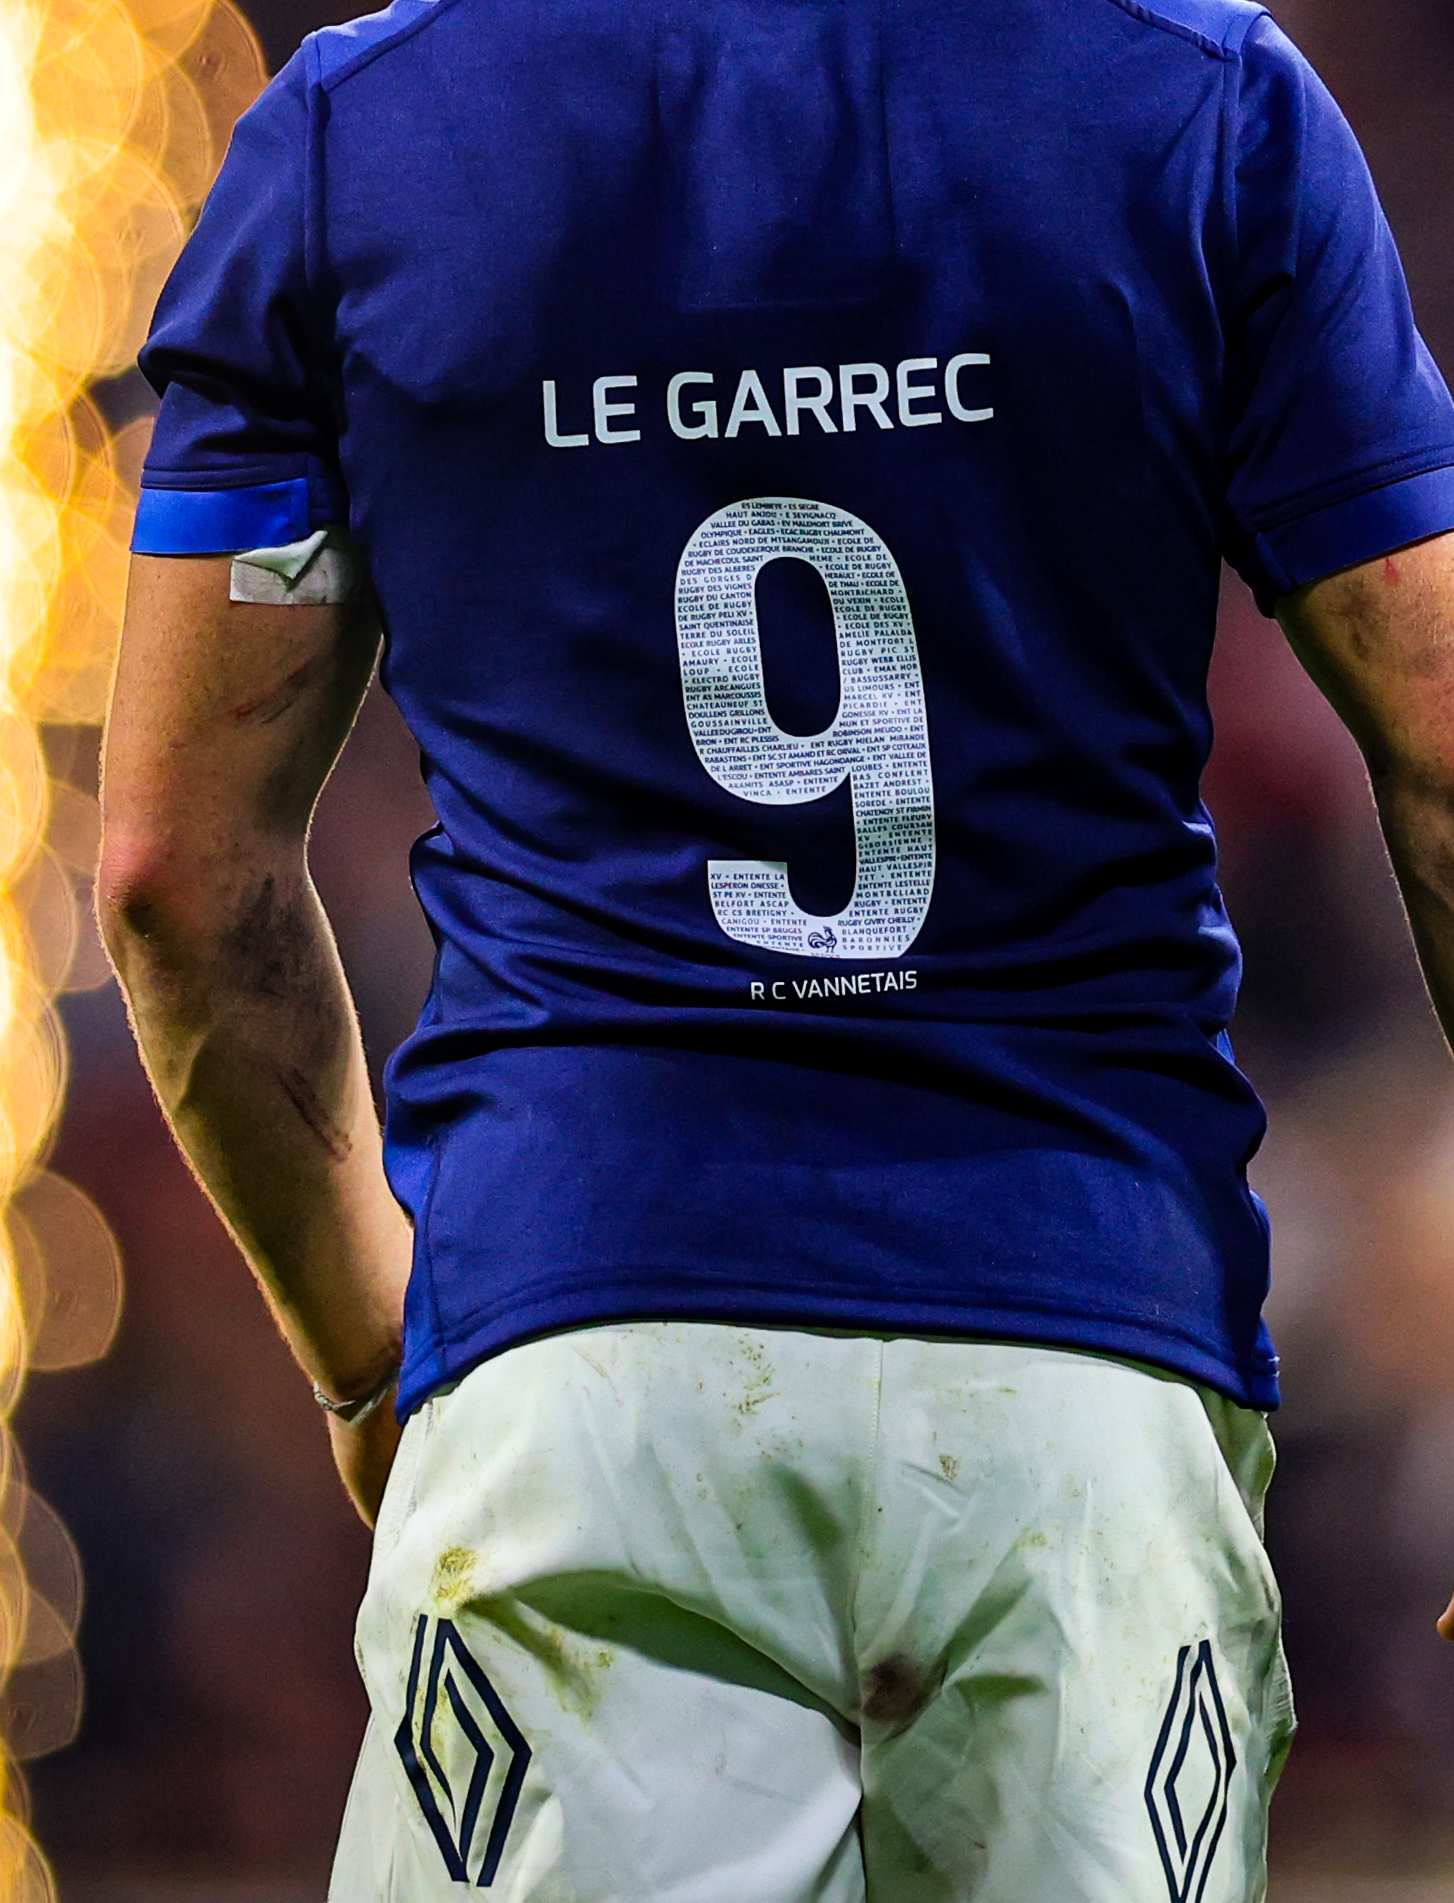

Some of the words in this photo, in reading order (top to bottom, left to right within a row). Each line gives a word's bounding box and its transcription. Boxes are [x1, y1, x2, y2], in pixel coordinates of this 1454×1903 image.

[543, 376, 640, 447] LE
[667, 353, 993, 439] GARREC
[738, 520, 750, 528] DU
[757, 537, 768, 545] DE
[865, 562, 891, 570] RUGBY
[680, 577, 698, 585] DES
[678, 586, 705, 595] RUGBY
[707, 585, 723, 593] DES
[678, 595, 704, 604] RUGBY
[706, 594, 718, 602] DU
[678, 604, 704, 613] ECOLE
[708, 603, 719, 611] DE
[724, 600, 752, 609] RUGBY
[690, 612, 716, 621] RUGBY
[736, 610, 747, 618] XV
[870, 613, 881, 621] DE
[710, 630, 723, 638] DU
[845, 622, 870, 630] ECOLE
[691, 648, 720, 657] ECOLE
[726, 646, 757, 655] RUGBY
[731, 655, 758, 664] ECOLE
[841, 648, 874, 657] RUGBY
[683, 667, 710, 676] LOUP
[728, 664, 759, 673] ECOLE
[841, 658, 868, 666] RUGBY
[732, 673, 760, 682] RUGBY
[685, 685, 712, 693] RUGBY
[904, 681, 920, 689] ENT
[905, 690, 921, 698] ENT
[904, 698, 922, 706] ENT
[675, 497, 936, 959] 9
[719, 728, 731, 736] DU
[827, 739, 853, 748] RUGBY
[786, 786, 826, 795] ENTENTE
[854, 790, 891, 799] ENTENTE
[863, 816, 899, 826] ENTENTE
[858, 834, 870, 842] XV
[888, 829, 933, 840] ENTENTE
[858, 847, 901, 858] ENTENTE
[907, 844, 933, 854] HAUT
[890, 870, 932, 880] ENTENTE
[856, 888, 930, 898] MONTBELIARD
[854, 899, 881, 908] RUGBY
[891, 897, 927, 906] ENTENTE
[849, 909, 889, 918] ENTENTE
[894, 907, 924, 915] RUGBY
[770, 918, 807, 926] ENTENTE
[842, 935, 910, 944] BARONNIES
[751, 982, 764, 1000] R
[772, 982, 786, 999] C
[792, 971, 917, 998] VANNETAIS
